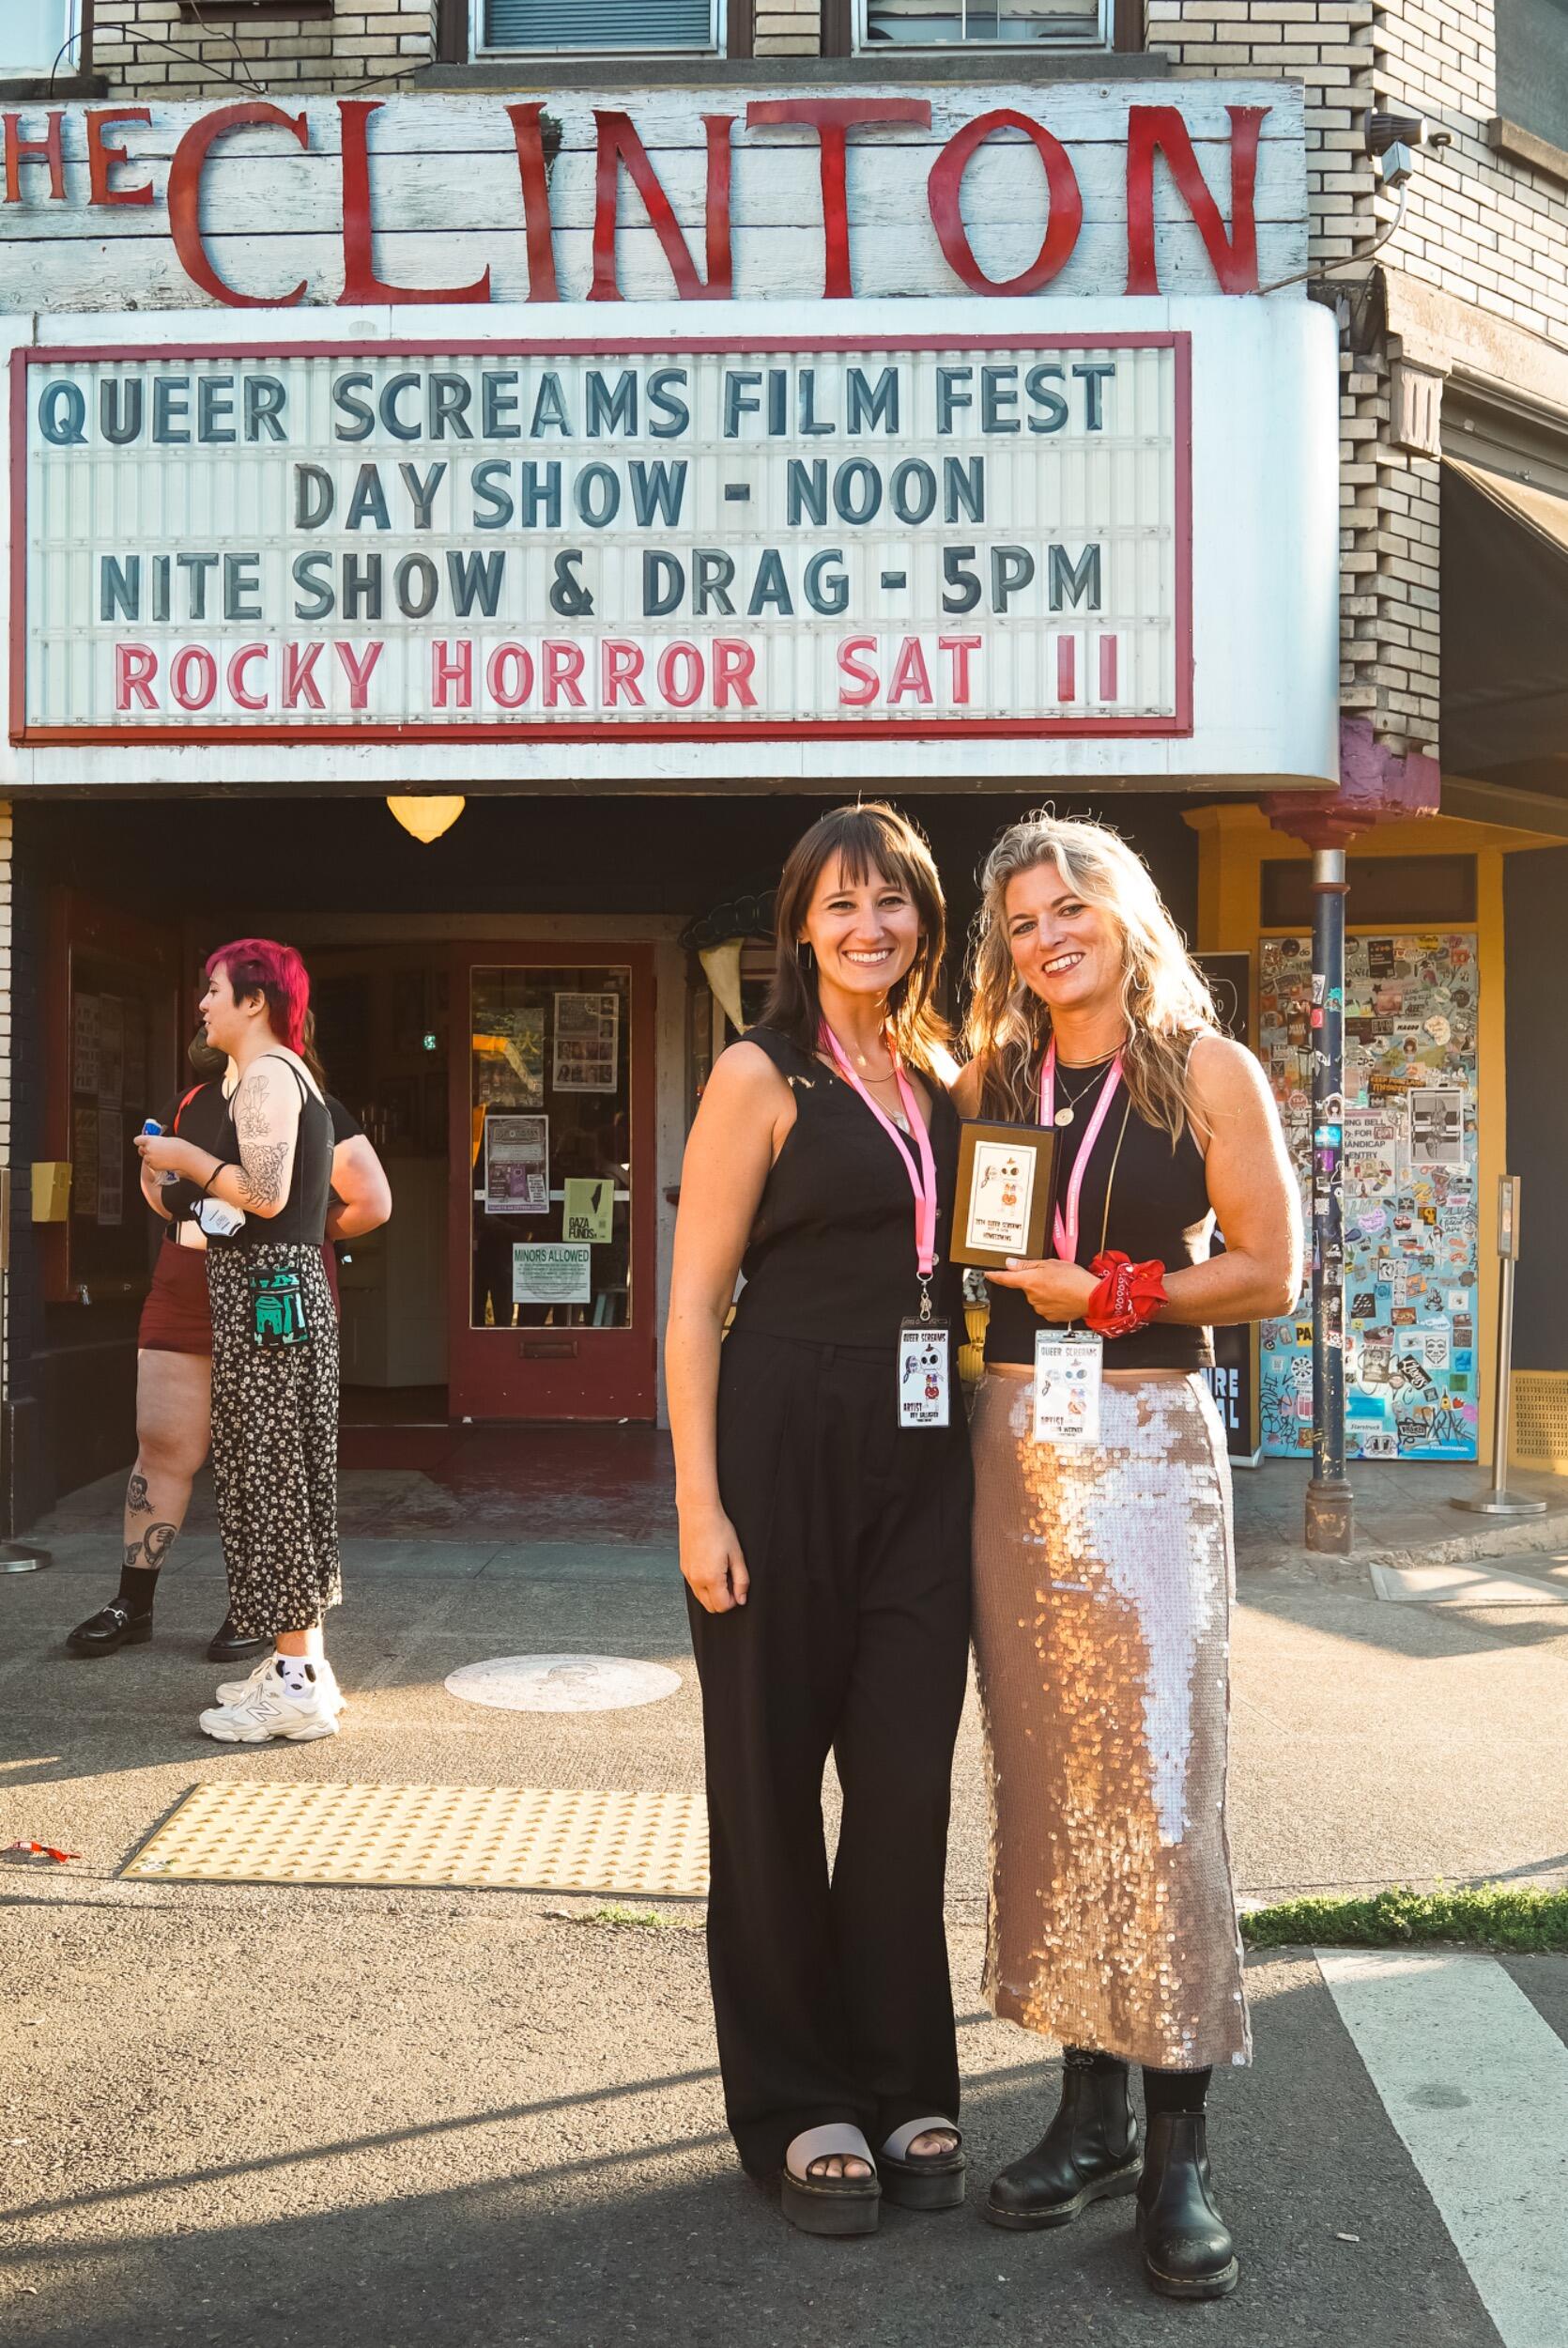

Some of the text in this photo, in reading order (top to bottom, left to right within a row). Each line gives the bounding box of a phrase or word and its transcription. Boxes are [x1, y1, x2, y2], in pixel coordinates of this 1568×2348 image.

[168, 98, 1272, 308] CLINTON
[37, 363, 1116, 445] QUEER SCREAMS FILM FEST
[294, 462, 448, 531] DAY
[470, 458, 688, 530] SHOW
[786, 456, 985, 526] NOON
[100, 552, 263, 622] NITE
[291, 549, 506, 621] SHOW
[548, 548, 595, 617] &
[641, 548, 850, 617] DRAG
[942, 544, 1102, 614] 5PM
[115, 641, 384, 710] ROCKY
[431, 639, 759, 709] HORROR
[837, 636, 983, 705] SAT
[515, 1249, 590, 1261] MINORS ALLOWED
